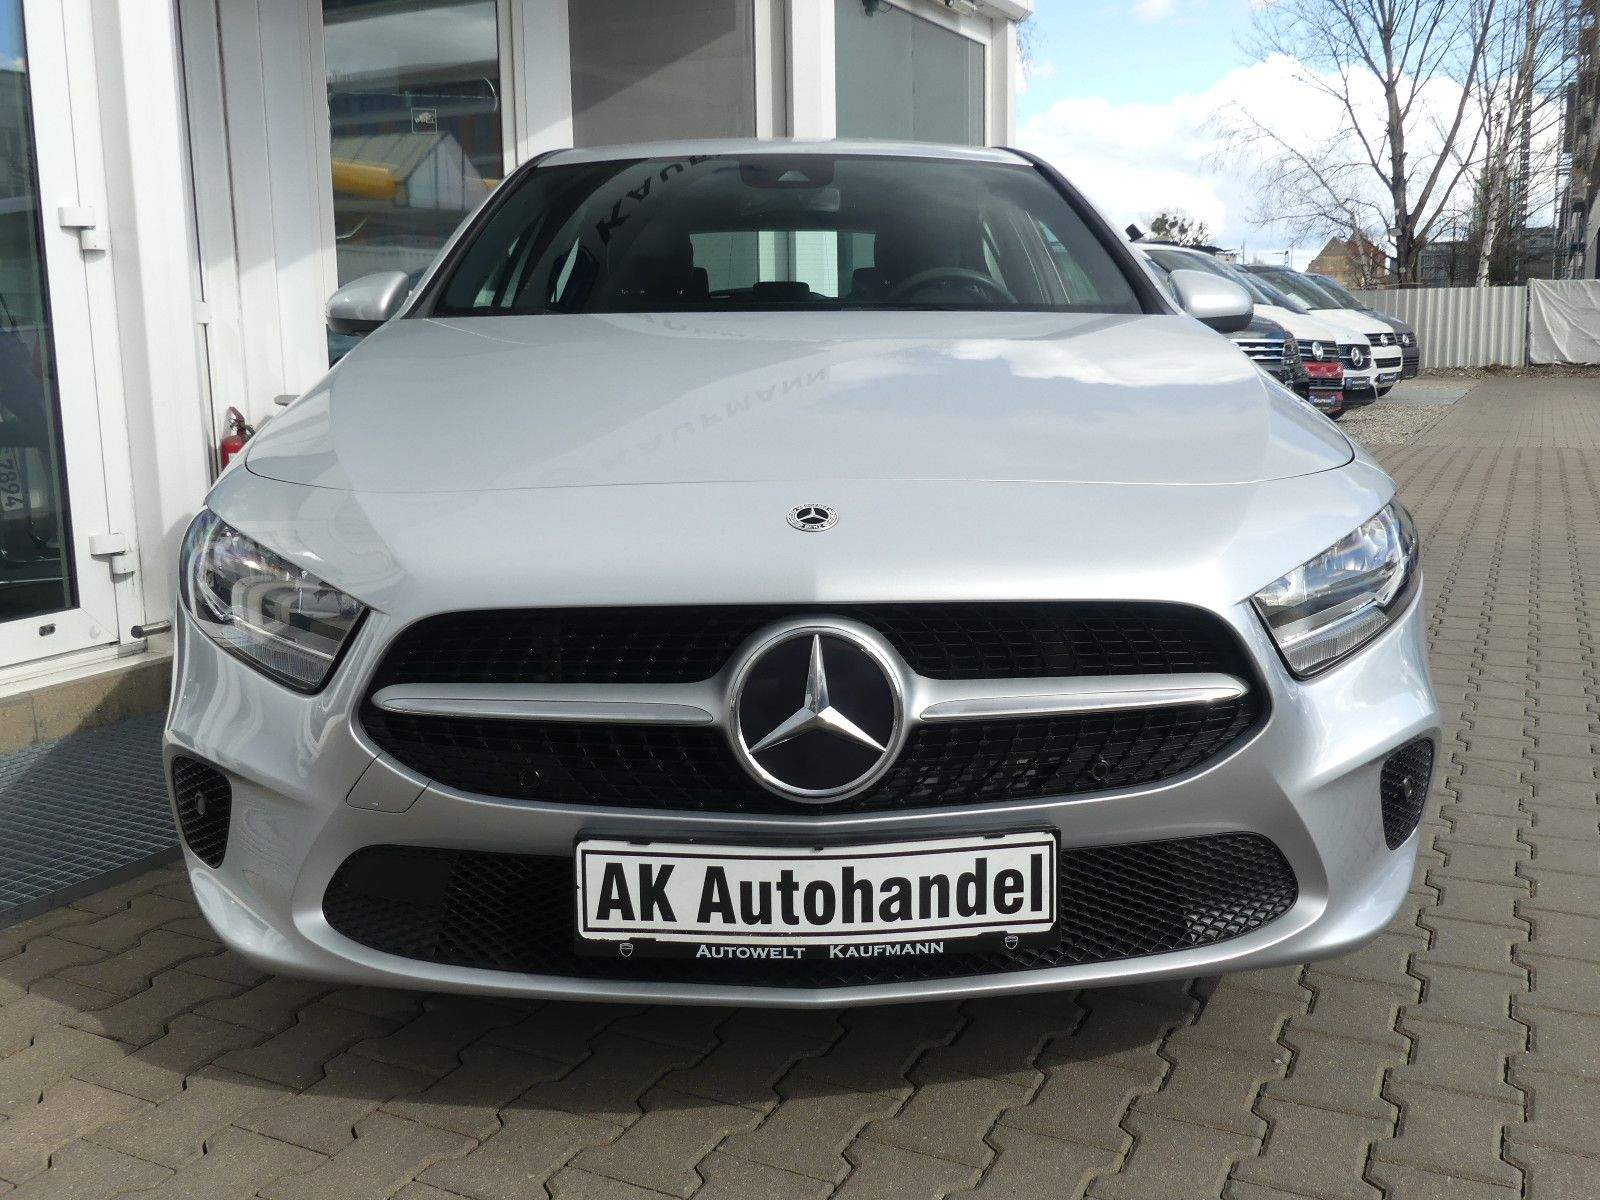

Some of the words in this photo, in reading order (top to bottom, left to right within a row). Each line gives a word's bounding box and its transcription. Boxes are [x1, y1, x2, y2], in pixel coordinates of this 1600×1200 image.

[596, 862, 678, 922] AK
[697, 853, 1043, 926] Autohandel
[696, 944, 806, 959] AUTOWELT
[829, 942, 944, 959] KAUFMANN
